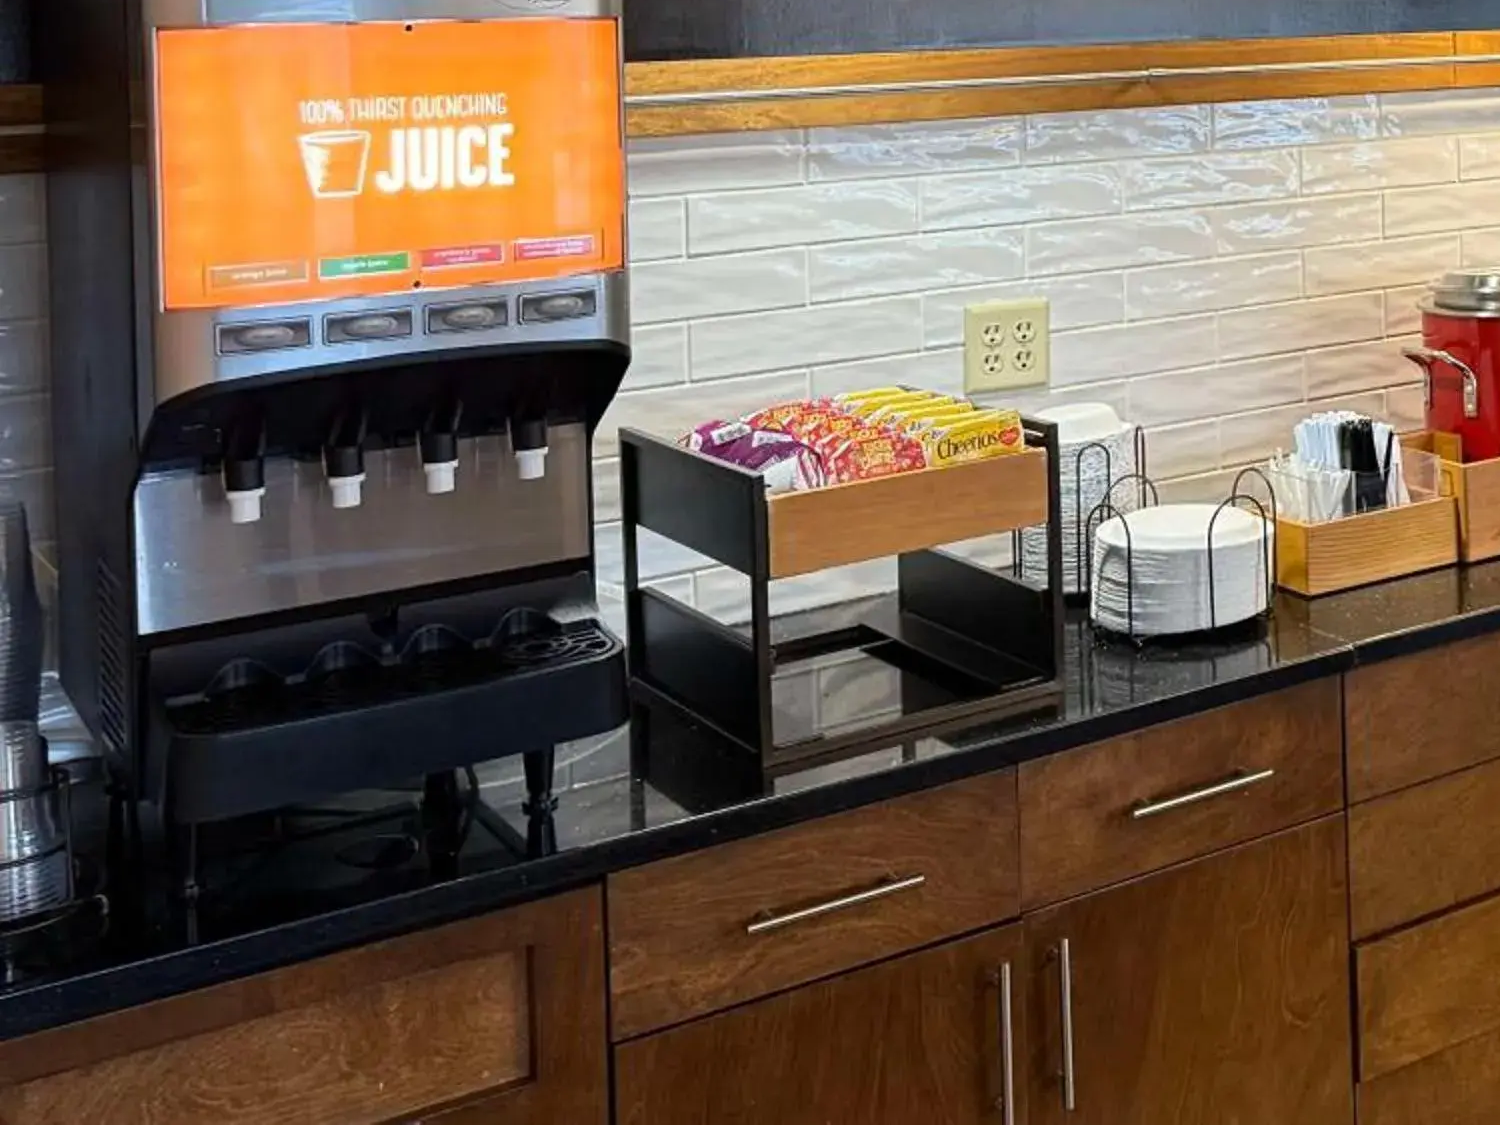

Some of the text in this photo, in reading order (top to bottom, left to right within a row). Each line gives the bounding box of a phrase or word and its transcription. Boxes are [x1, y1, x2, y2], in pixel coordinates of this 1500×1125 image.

[300, 92, 508, 124] 100% THIRST QUENCHING
[375, 123, 515, 194] JUICE
[937, 430, 998, 460] Cheerios
